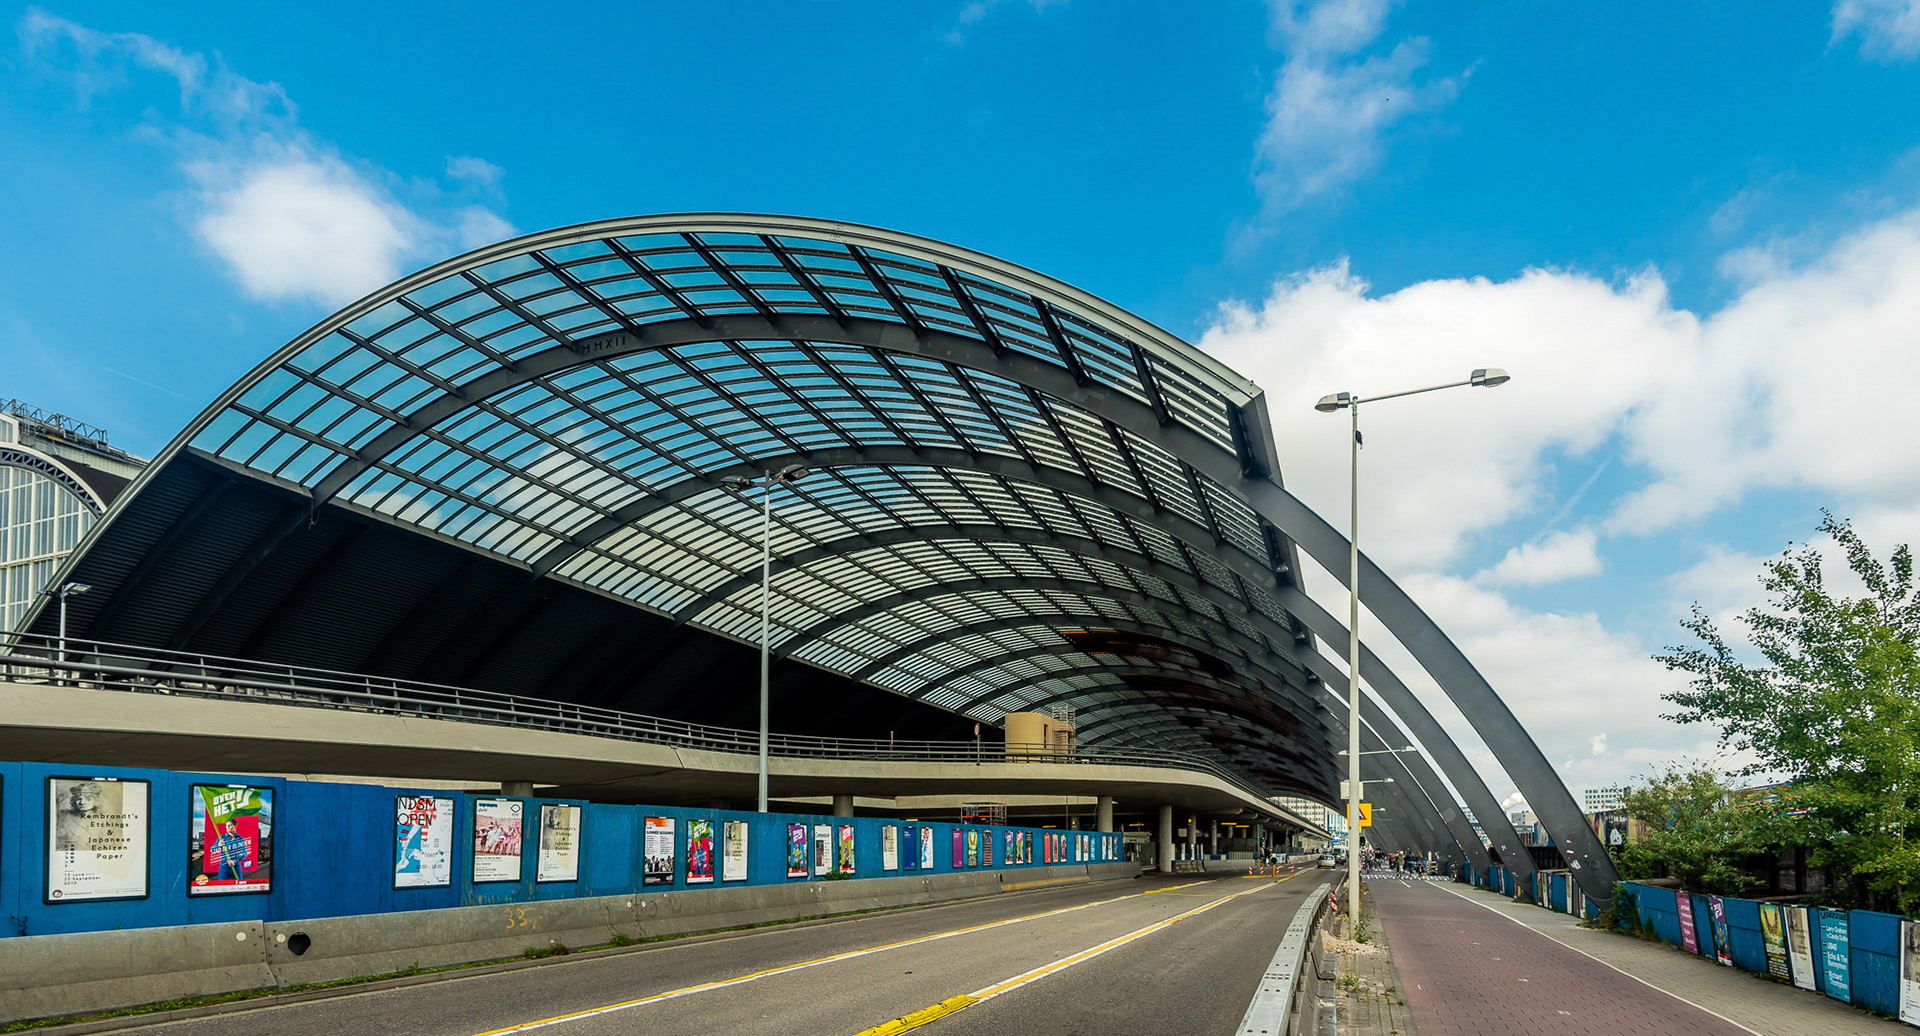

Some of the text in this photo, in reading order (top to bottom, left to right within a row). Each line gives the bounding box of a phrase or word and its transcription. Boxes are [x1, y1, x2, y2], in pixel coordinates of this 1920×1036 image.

[582, 335, 626, 355] MMXII
[213, 791, 236, 805] OVER
[398, 797, 436, 811] NDSM
[213, 800, 236, 817] HET
[80, 812, 139, 820] Rembrandt's
[398, 812, 433, 827] OPEN
[90, 821, 129, 829] Etchings
